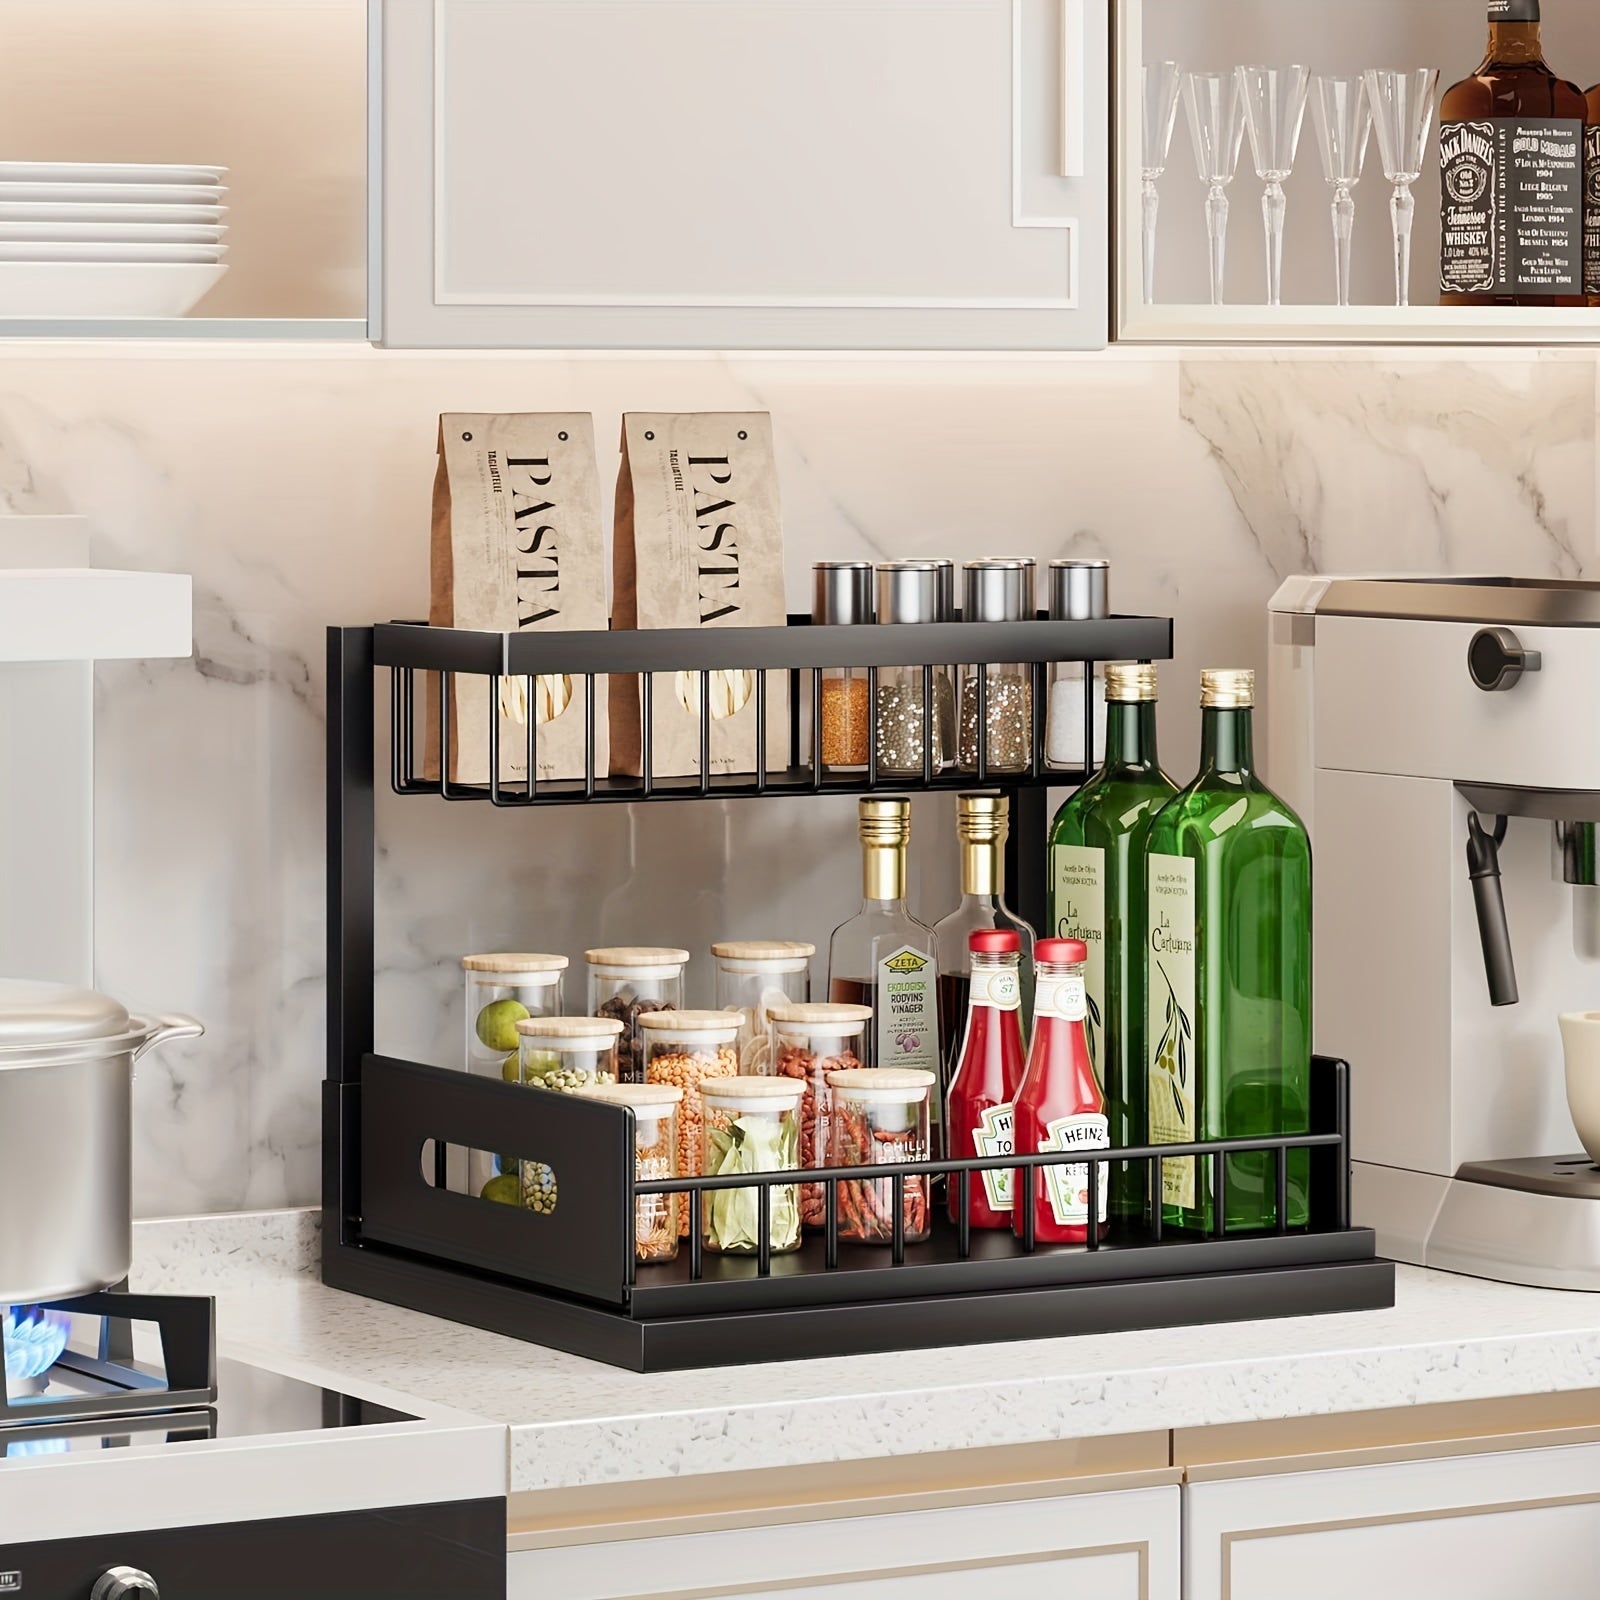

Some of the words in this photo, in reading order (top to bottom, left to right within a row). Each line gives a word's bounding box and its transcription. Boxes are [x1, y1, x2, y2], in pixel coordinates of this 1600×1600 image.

[1440, 135, 1461, 168] JACK
[1461, 128, 1494, 166] DANIEL'S
[1447, 206, 1486, 225] Tennessee
[1445, 231, 1488, 246] WHISKEY
[488, 451, 502, 493] TAGLIATELLE
[669, 449, 684, 492] TAGLIATELLE
[505, 449, 561, 632] PASTA
[688, 448, 741, 625] PASTA
[1067, 901, 1078, 918] La
[1160, 911, 1170, 928] La
[895, 958, 919, 968] ZETA
[887, 982, 926, 992] EKOLOGISK
[1065, 1127, 1103, 1144] HEINZ
[883, 1140, 925, 1152] CHILLI
